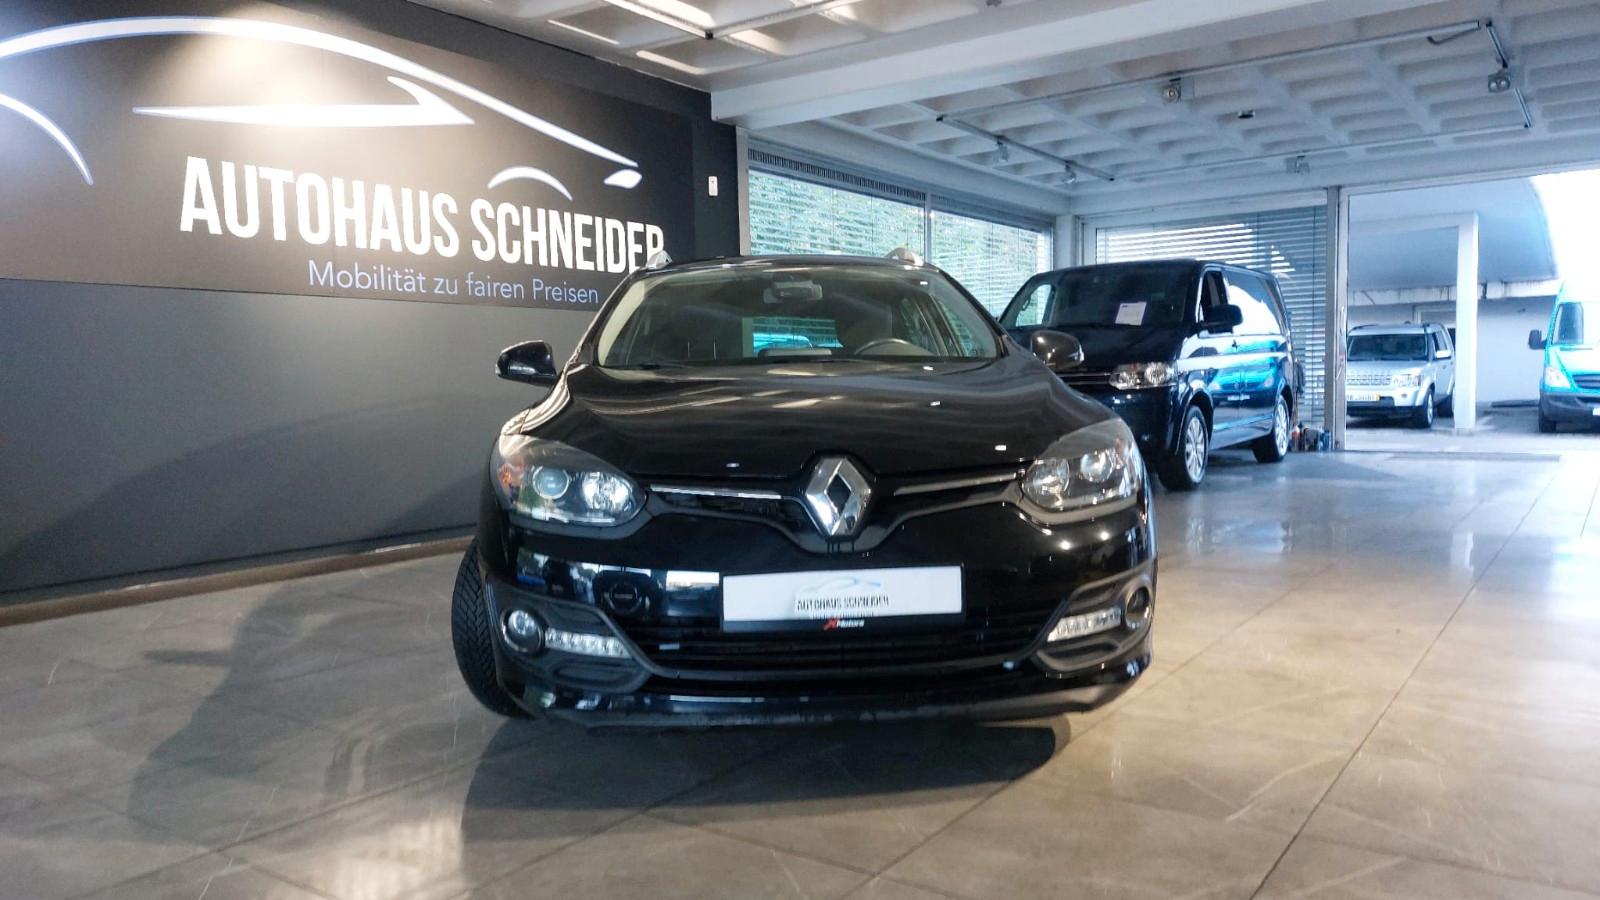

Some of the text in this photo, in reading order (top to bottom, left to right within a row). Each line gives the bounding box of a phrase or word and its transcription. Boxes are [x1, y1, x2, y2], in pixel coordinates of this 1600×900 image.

[180, 156, 665, 274] AUTOHAUS SCHNEIDER
[308, 259, 599, 305] Mobilität zu fairen Preisen
